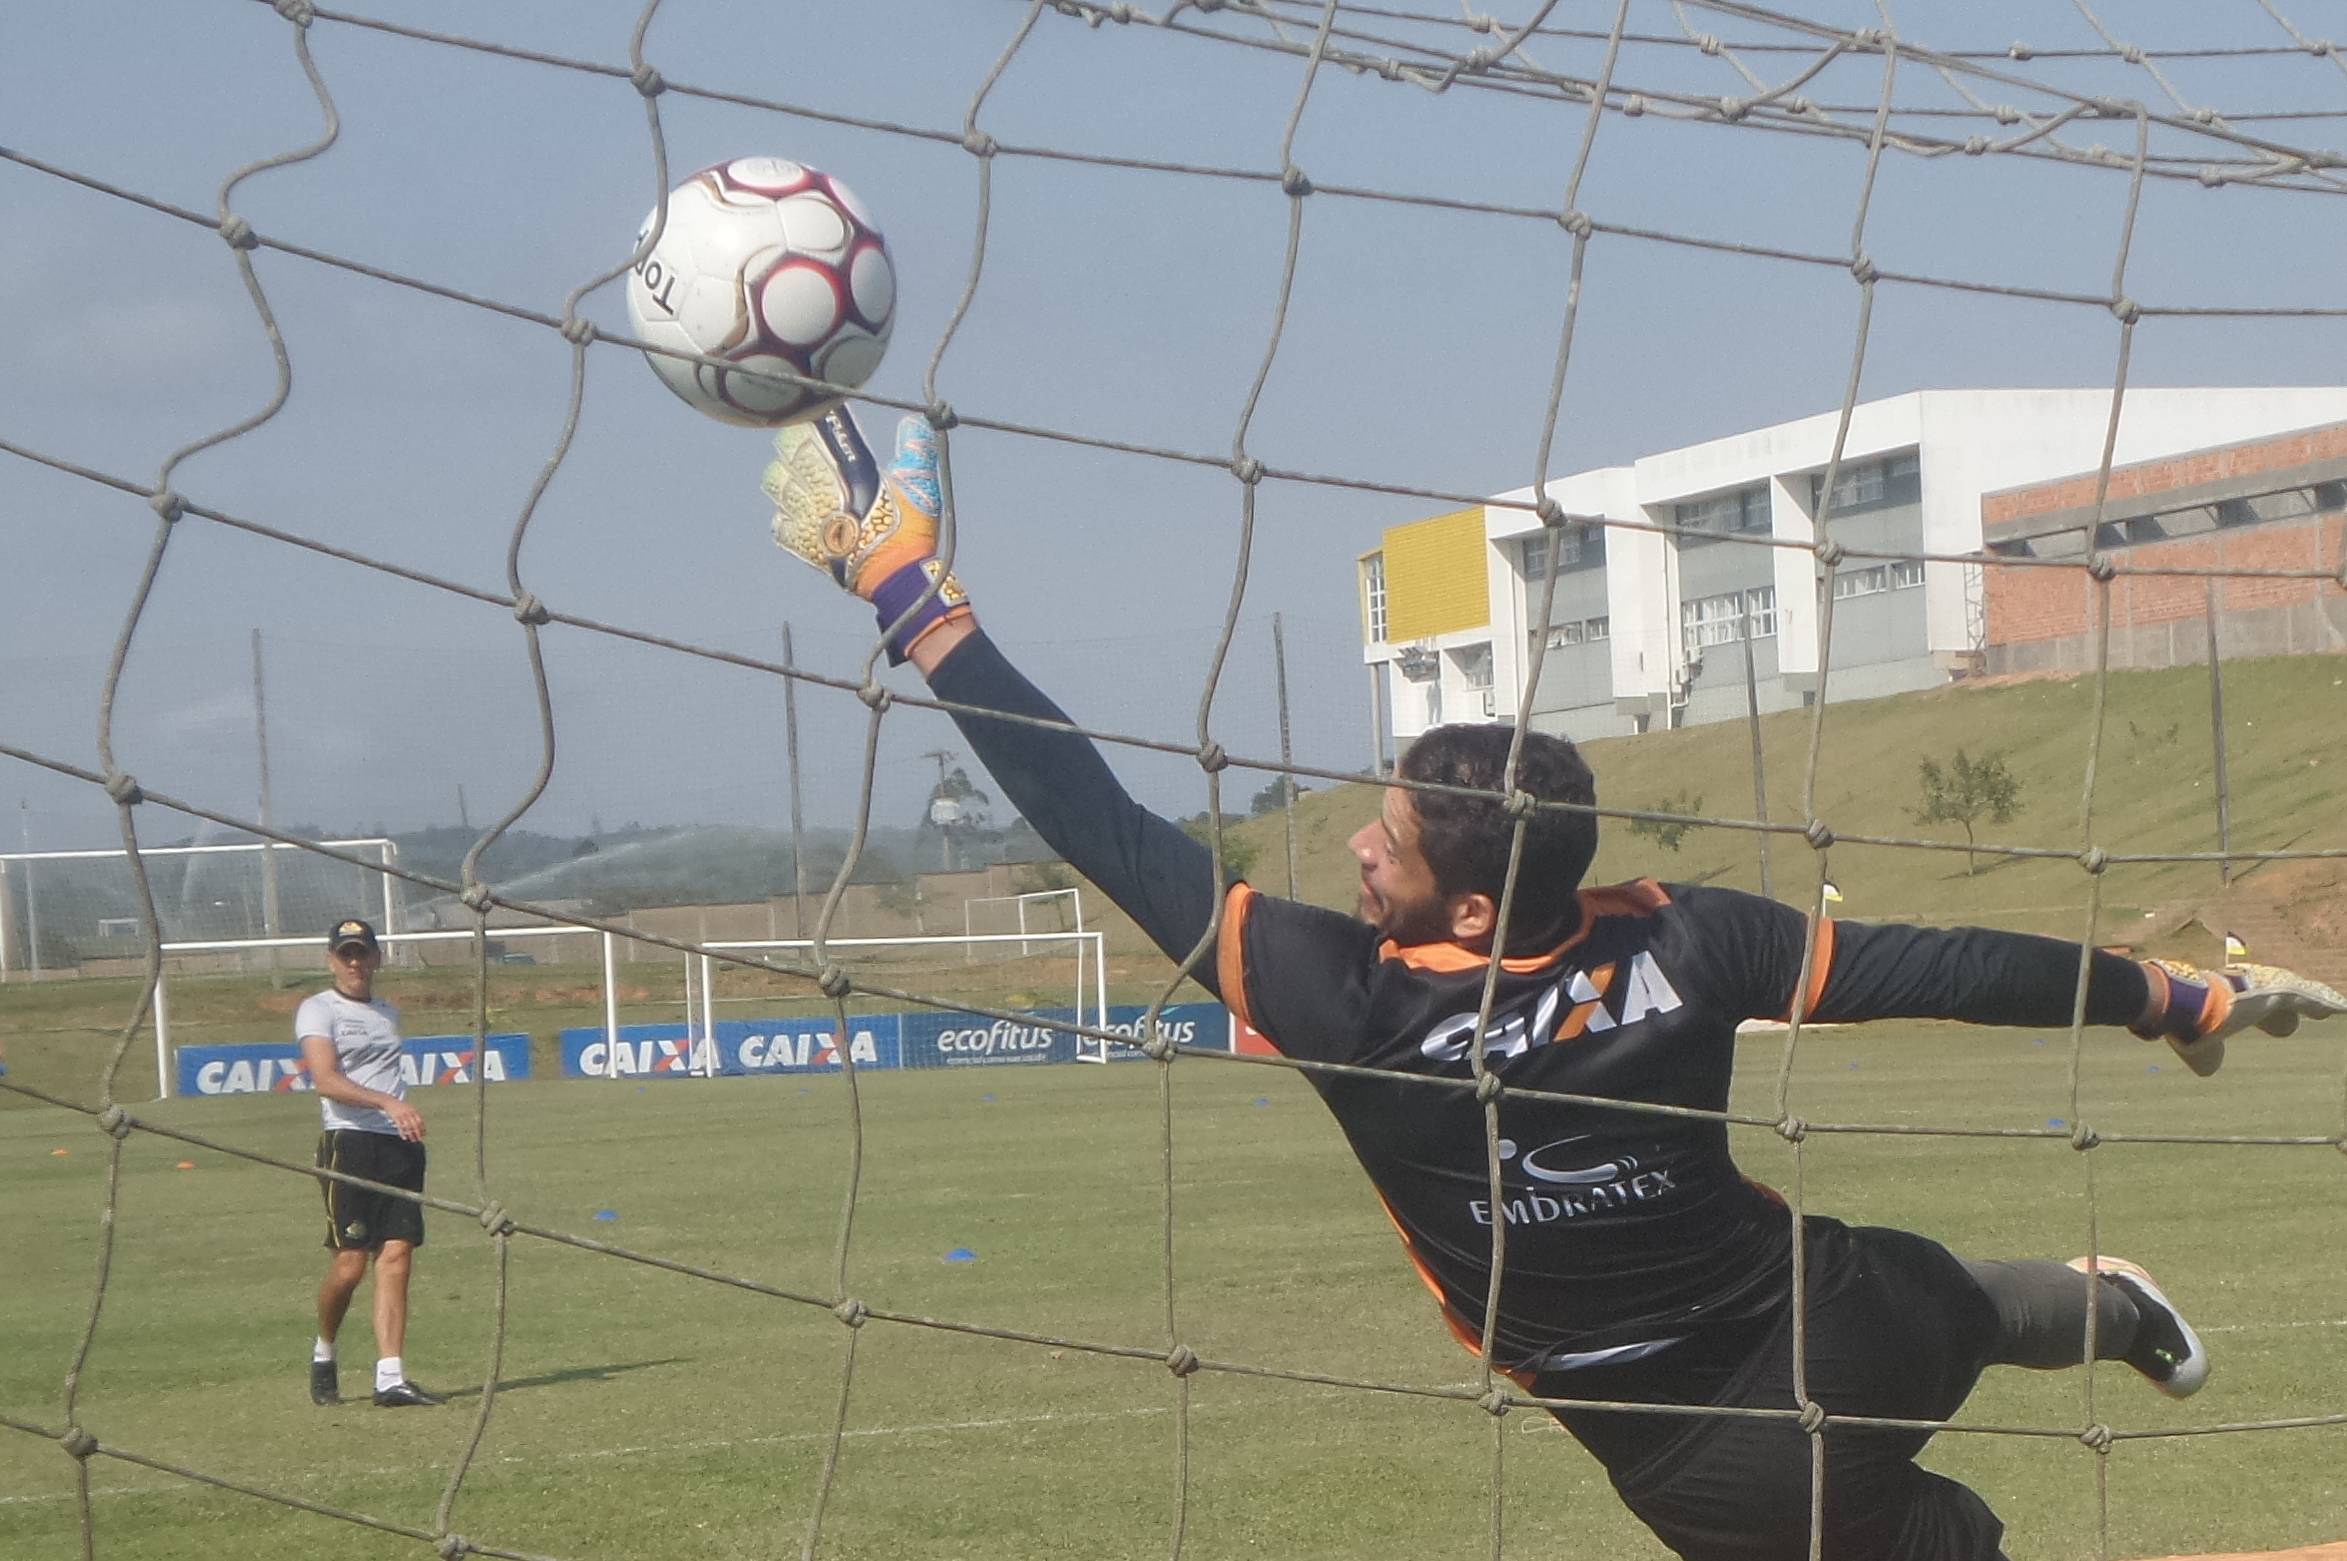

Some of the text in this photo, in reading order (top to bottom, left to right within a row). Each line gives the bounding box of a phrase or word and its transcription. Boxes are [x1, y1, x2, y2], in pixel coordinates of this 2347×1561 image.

[739, 1031, 878, 1068] CAIXA
[937, 1020, 1053, 1055] ecofitus
[399, 1050, 506, 1087] AIXA
[579, 1038, 721, 1076] CAIXA
[196, 1058, 317, 1095] CAIX
